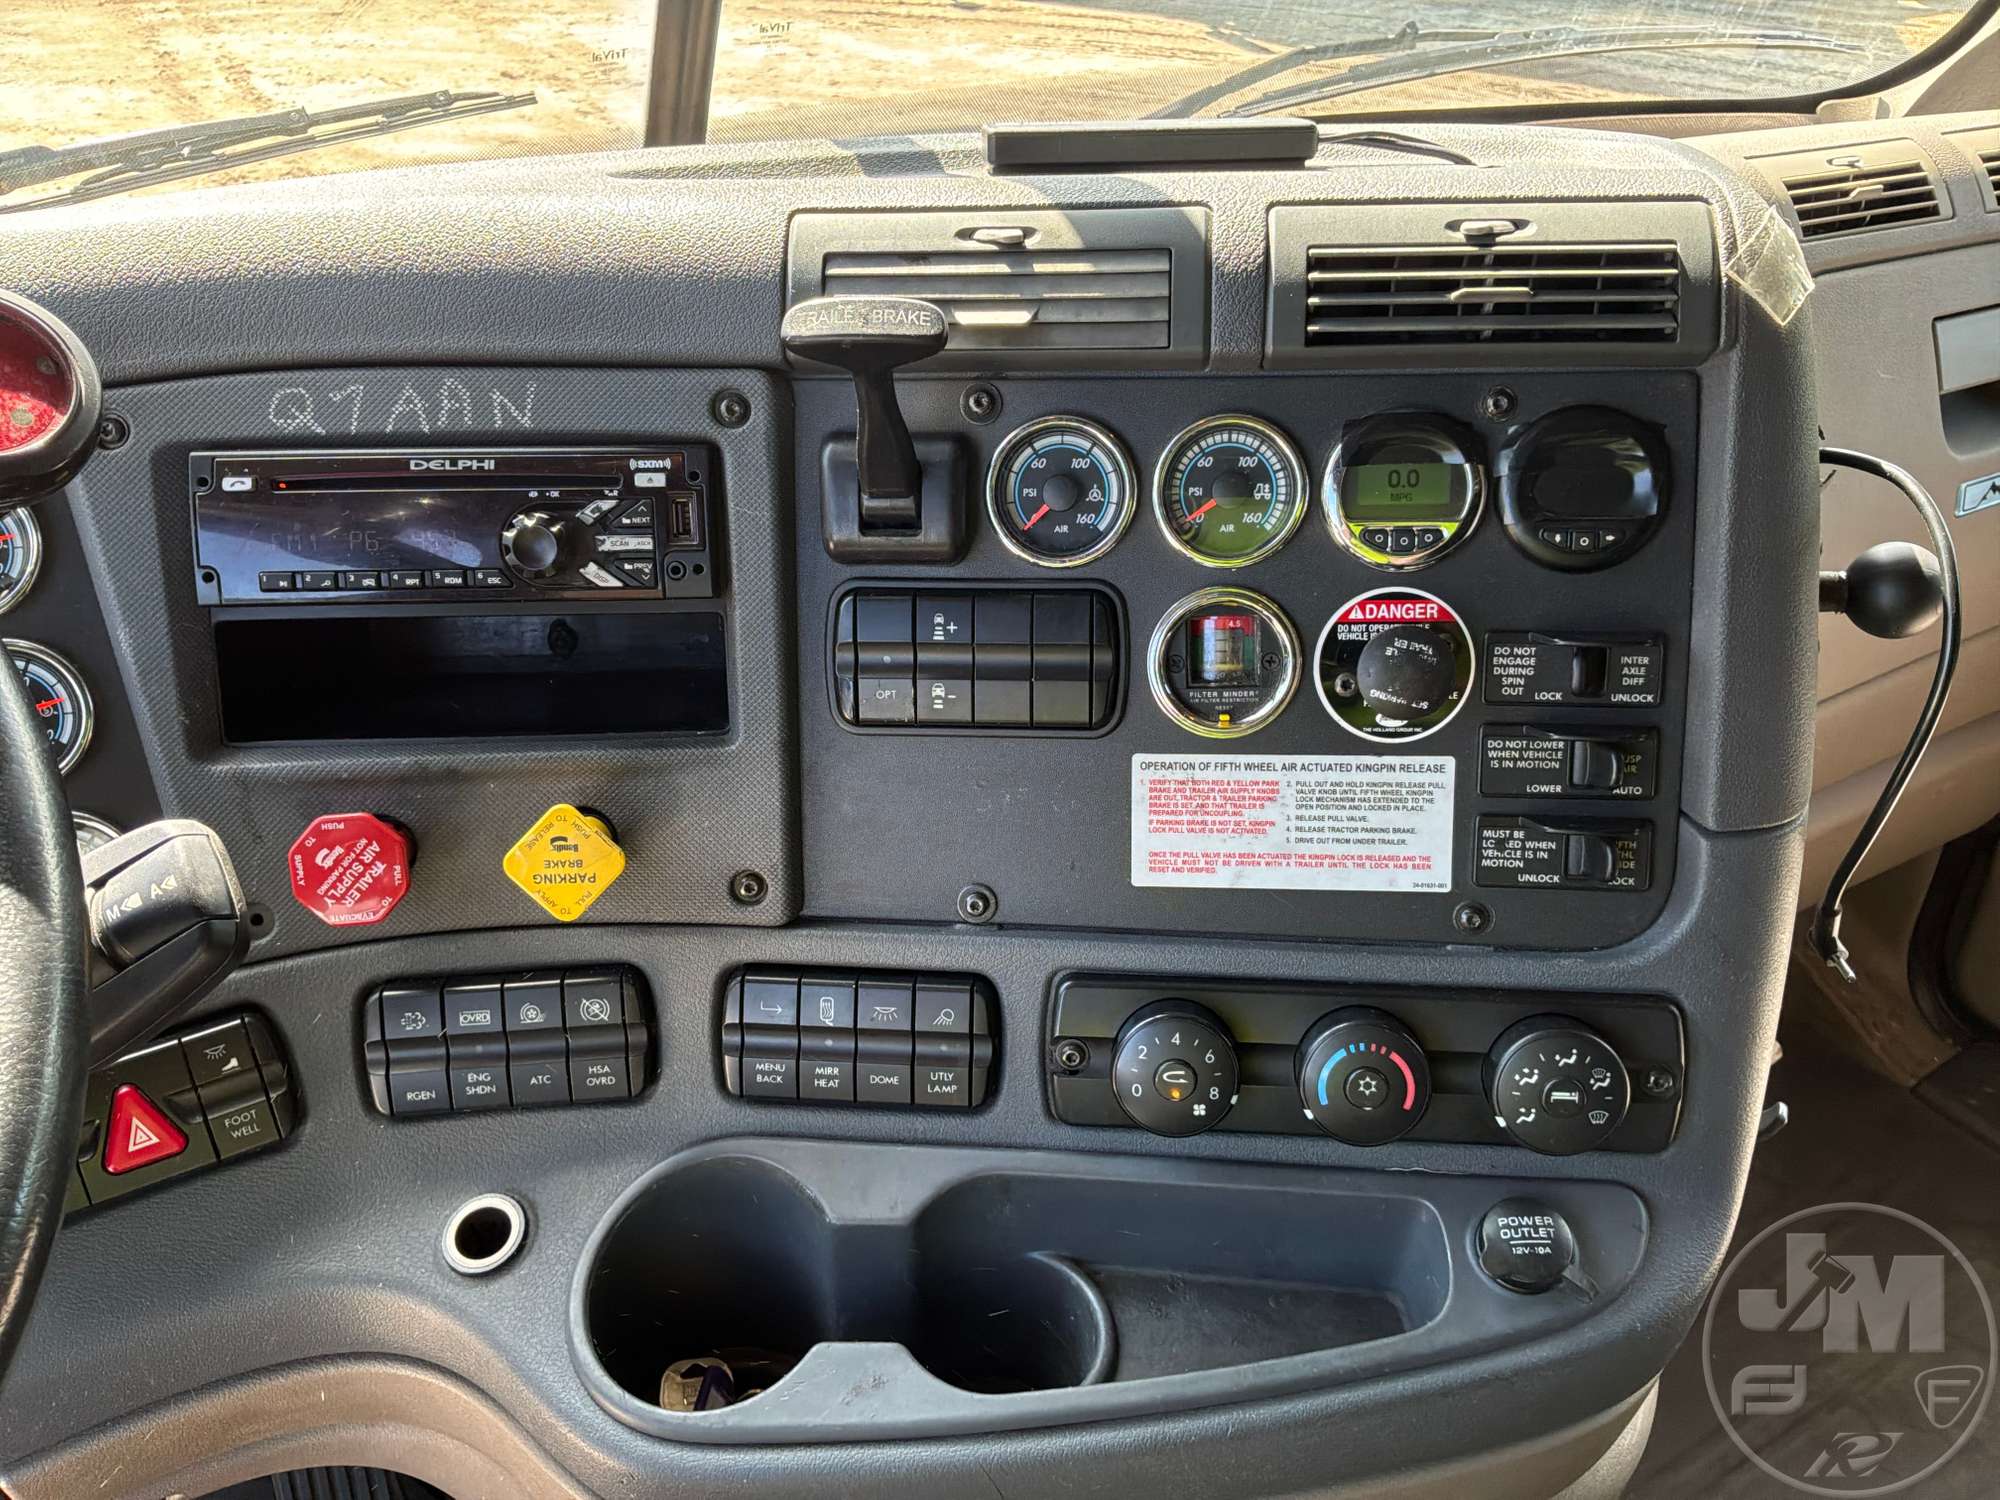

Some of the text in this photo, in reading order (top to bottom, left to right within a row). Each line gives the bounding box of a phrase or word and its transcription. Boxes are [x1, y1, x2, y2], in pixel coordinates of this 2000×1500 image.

[872, 309, 931, 326] BRAKE
[410, 460, 495, 471] DELPHI
[1031, 458, 1046, 469] 60
[1071, 458, 1090, 469] 100
[1198, 457, 1213, 468] 60
[1238, 457, 1258, 468] 100
[1388, 469, 1420, 489] 0.0
[1023, 487, 1037, 498] PSI
[1188, 487, 1203, 497] PSI
[1076, 513, 1095, 525] 160
[1242, 513, 1262, 524] 160
[1054, 525, 1069, 534] AIR
[1220, 524, 1235, 533] AIR
[349, 574, 355, 582] 3
[1365, 604, 1438, 619] DANGER
[1338, 624, 1349, 632] DO
[1351, 624, 1367, 632] NOT
[1337, 633, 1368, 641] VEHICLE
[1494, 647, 1536, 656] DO NOT
[1493, 657, 1537, 666] ENGAGE
[1621, 656, 1649, 665] INTER
[1493, 667, 1535, 676] DURING
[1621, 667, 1647, 675] AXLE
[1502, 677, 1525, 686] SPIN
[1622, 677, 1645, 686] DIFF
[876, 690, 897, 700] OPT
[1502, 687, 1524, 696] OUT
[1535, 692, 1563, 701] LOCK
[1611, 694, 1654, 703] UNLOCK
[1487, 740, 1565, 749] DO NOT LOWER
[1487, 750, 1564, 759] WHEN VEHICLE
[1140, 762, 1446, 773] OPERATION OF FIFTH WHEEL AIR ACTUATED KINGPIN RELEASE
[1491, 760, 1500, 768] IS
[1516, 761, 1560, 769] MOTION
[1527, 785, 1562, 793] LOWER
[321, 822, 345, 831] PUSH
[571, 822, 592, 840] PUSH
[1482, 830, 1525, 839] MUST BE
[305, 836, 317, 847] TO
[354, 838, 369, 853] NOT
[1525, 841, 1556, 850] WHEN
[359, 841, 381, 864] AIR
[1525, 851, 1548, 859] IS IN
[340, 852, 356, 867] FOR
[544, 860, 583, 869] BRAKE
[1481, 859, 1524, 868] MOTION
[294, 854, 305, 886] SUPPLY
[393, 865, 402, 886] PULL
[317, 866, 345, 896] PARKING
[340, 860, 387, 907] TRAILER
[532, 873, 596, 885] PARKING
[1518, 874, 1560, 883] UNLOCK
[150, 882, 163, 899] A
[324, 862, 364, 908] SUPPLY
[382, 896, 393, 906] TO
[535, 889, 559, 908] APPLY
[106, 905, 121, 922] M
[560, 907, 571, 915] TO
[461, 1012, 490, 1024] OVRD
[1171, 1033, 1181, 1046] 4
[1138, 1046, 1148, 1060] 2
[1205, 1049, 1215, 1063] 6
[588, 1065, 612, 1075] HSA
[755, 1063, 786, 1072] MENU
[815, 1066, 839, 1076] MIRR
[468, 1072, 491, 1083] ENG
[530, 1074, 552, 1085] ATC
[586, 1076, 616, 1087] OVRD
[756, 1074, 784, 1084] BACK
[870, 1074, 900, 1085] DOME
[931, 1072, 954, 1082] UTLY
[815, 1078, 840, 1088] HEAT
[465, 1084, 496, 1096] SHDN
[927, 1084, 958, 1094] LAMP
[1132, 1083, 1143, 1098] 0
[1209, 1087, 1219, 1100] 8
[407, 1090, 436, 1101] RGEN
[224, 1109, 257, 1128] FOOT
[231, 1124, 261, 1139] WELL
[1498, 1216, 1555, 1227] POWER
[1500, 1228, 1556, 1239] OUTLET
